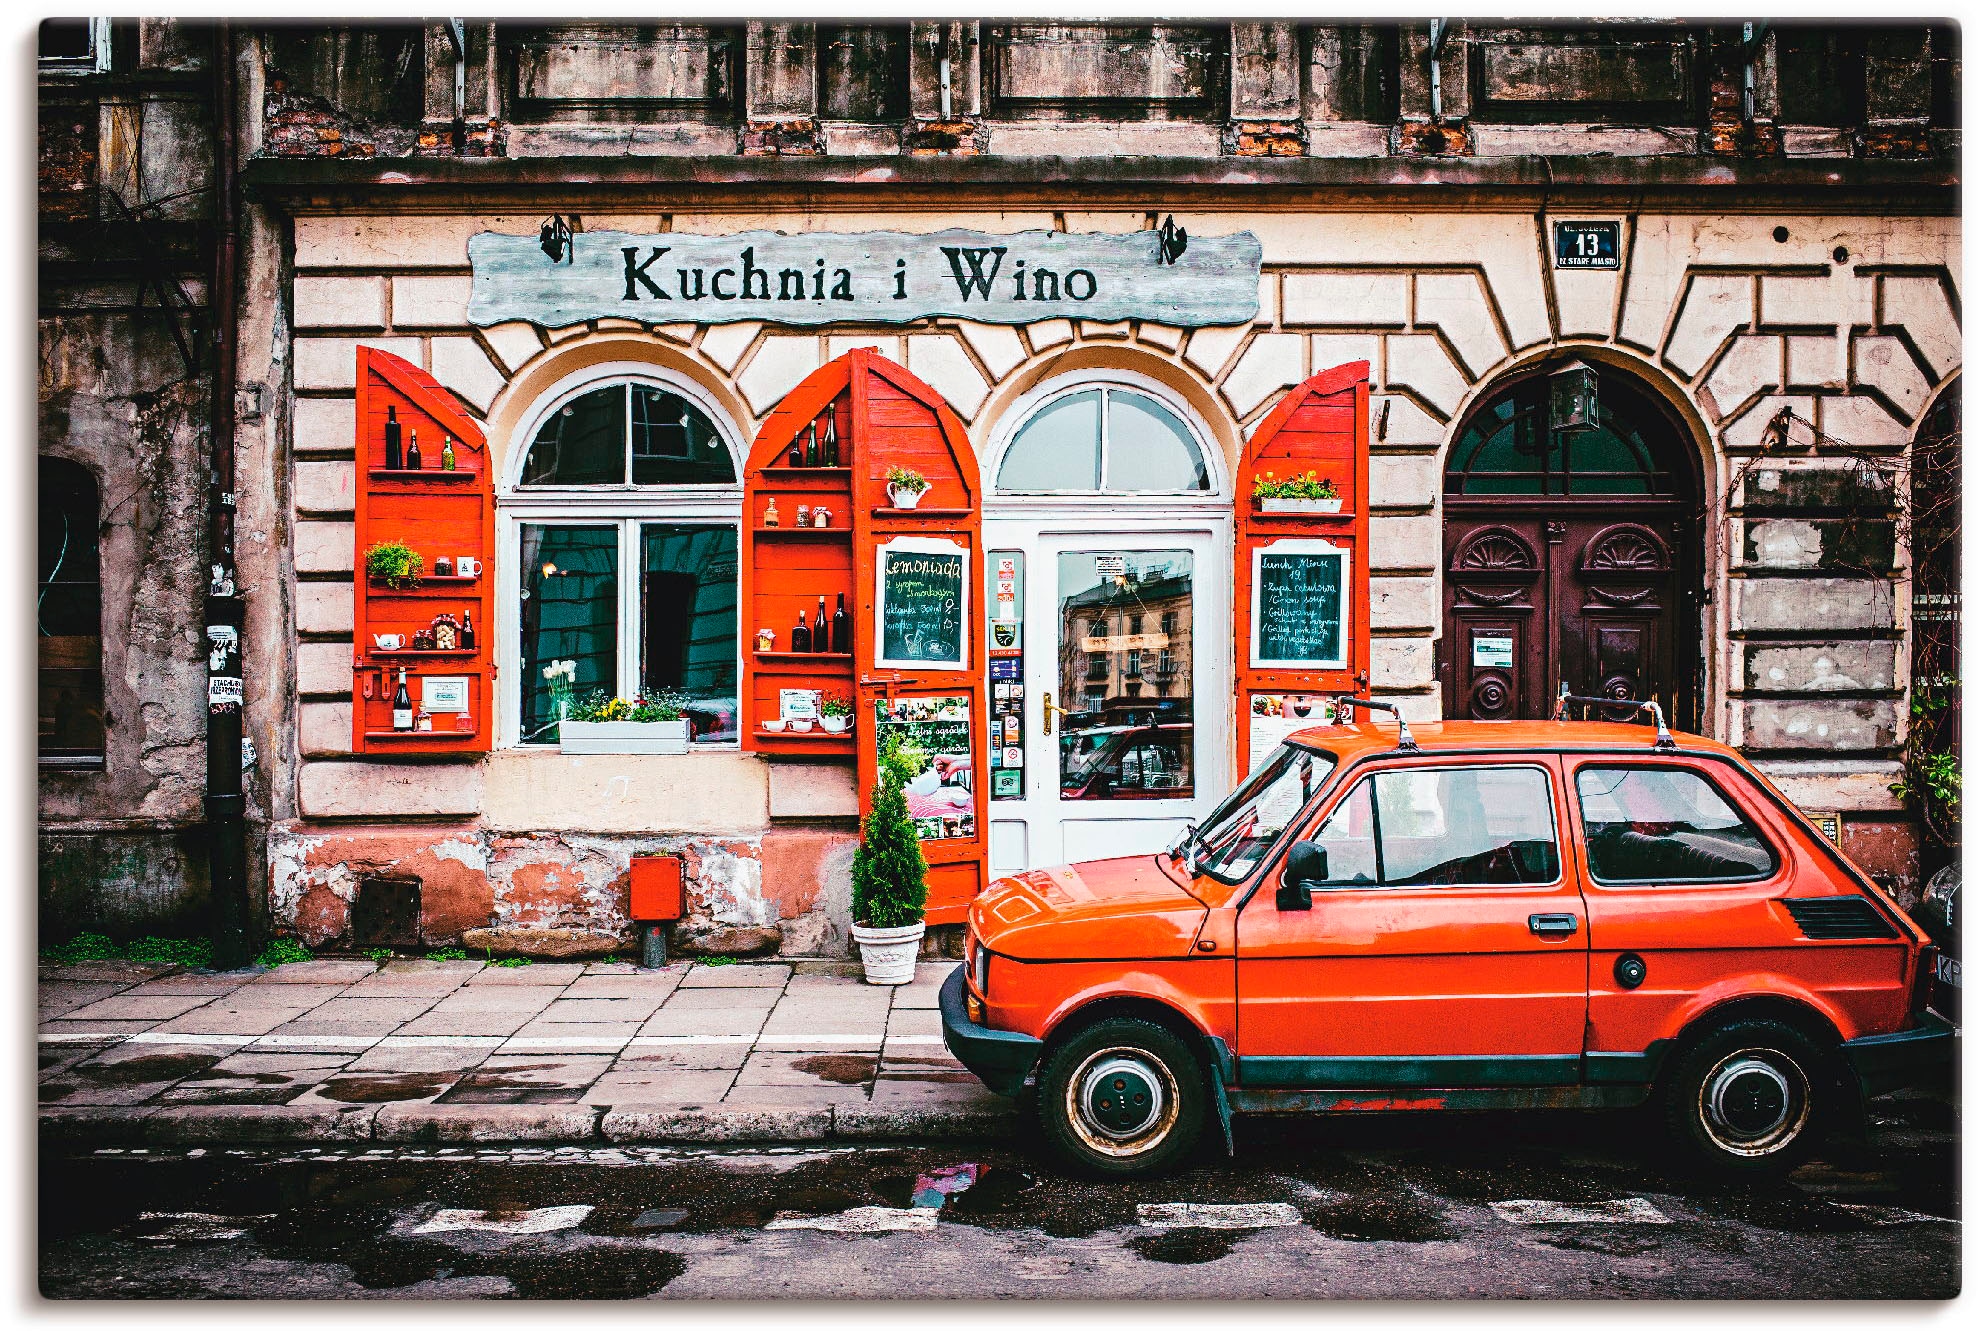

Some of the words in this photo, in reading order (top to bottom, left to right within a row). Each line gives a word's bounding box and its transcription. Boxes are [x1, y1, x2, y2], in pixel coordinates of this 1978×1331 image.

[1576, 233, 1598, 255] 13
[622, 246, 855, 303] Kuchnia
[893, 257, 907, 300] i
[940, 246, 1098, 302] Wino
[885, 553, 961, 578] Lemoniada
